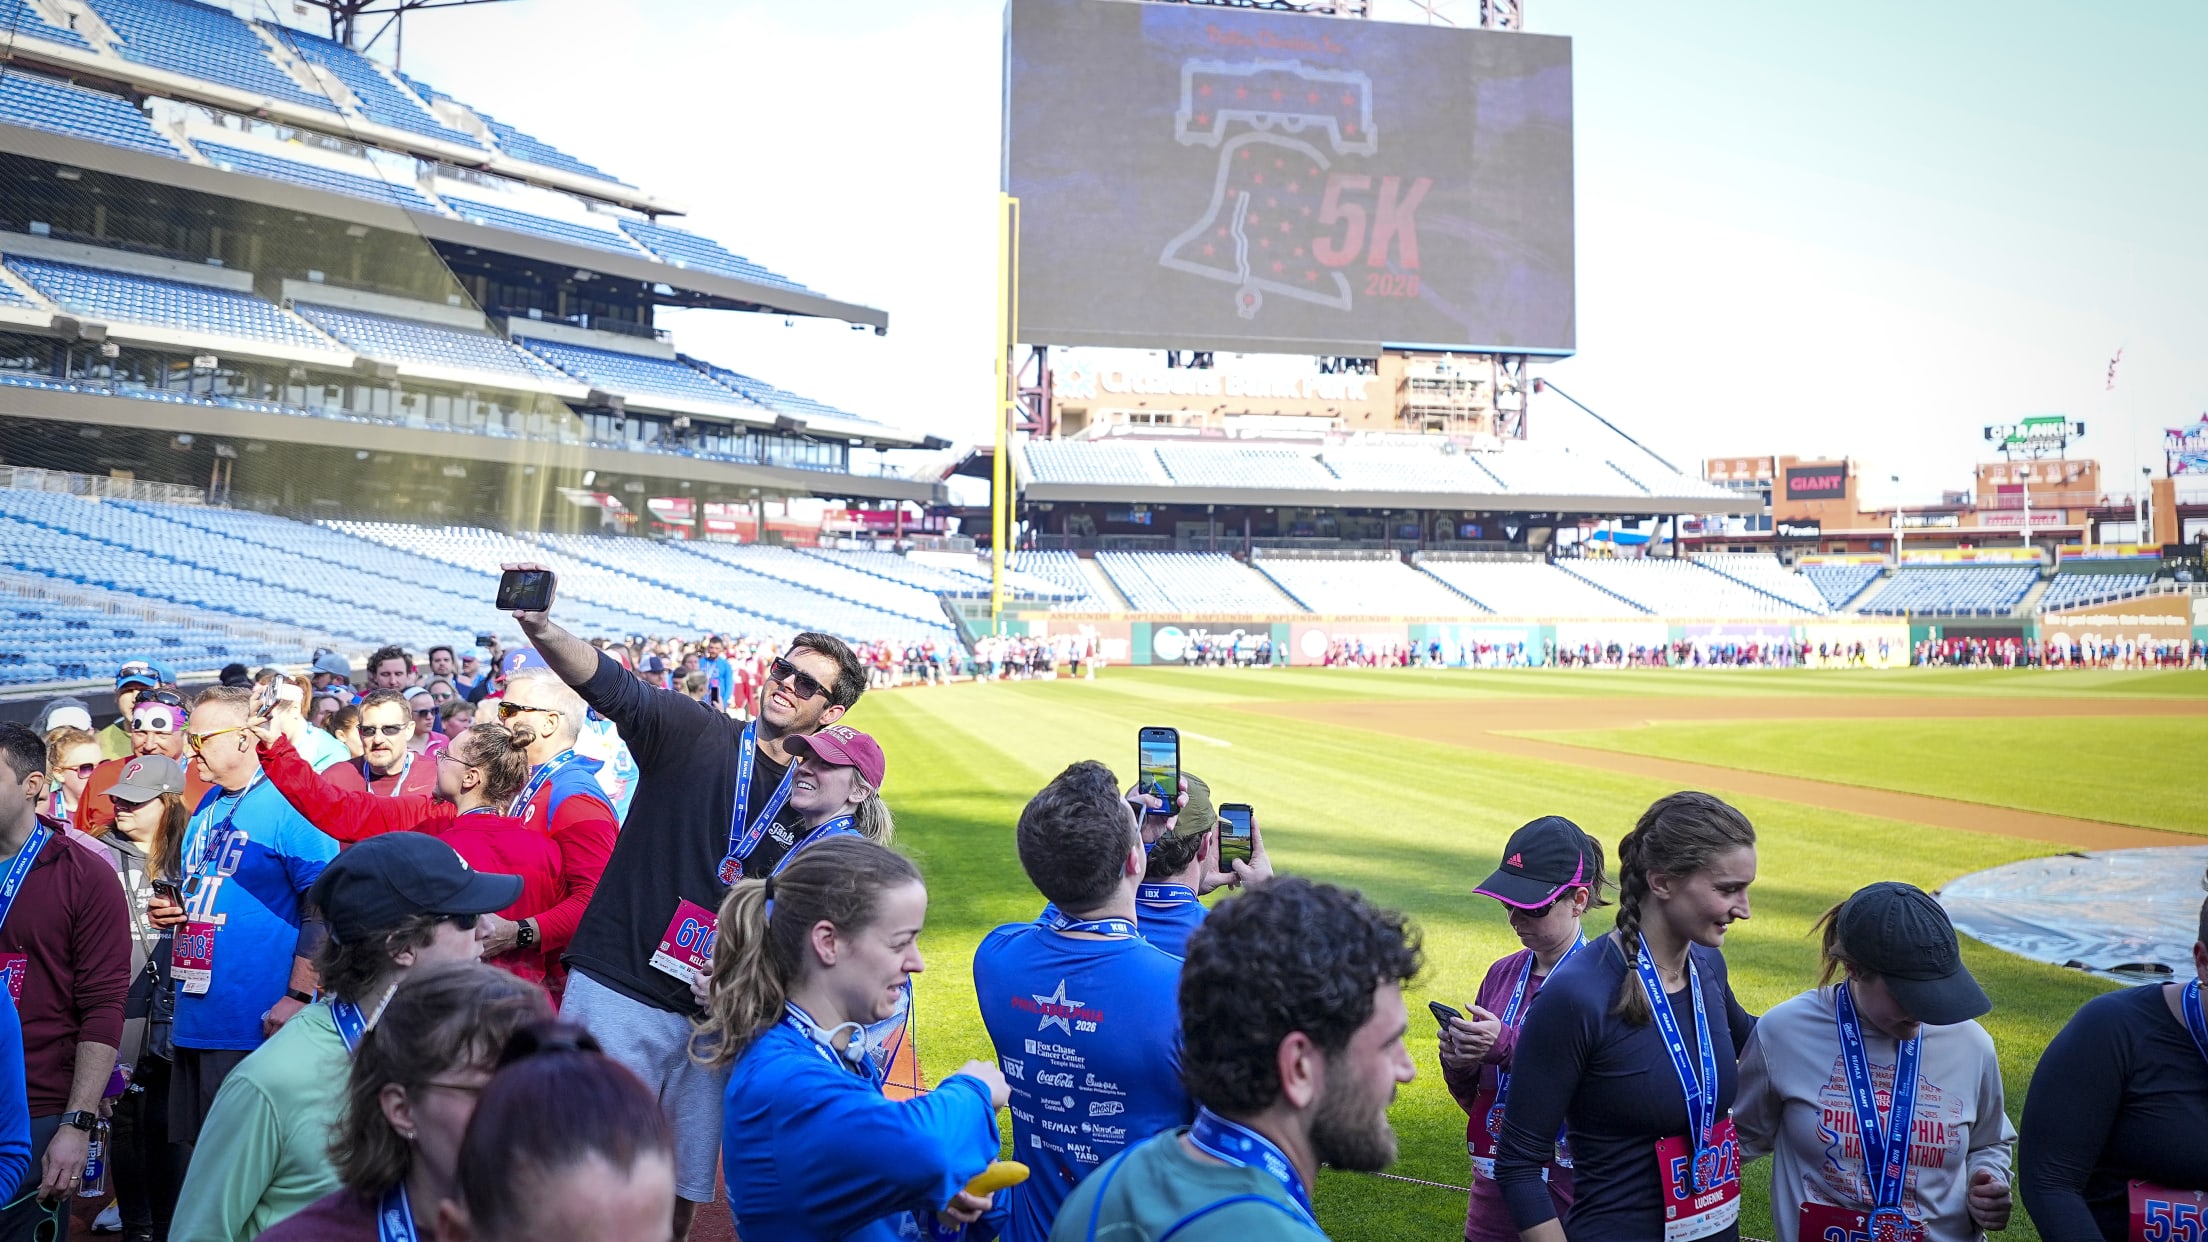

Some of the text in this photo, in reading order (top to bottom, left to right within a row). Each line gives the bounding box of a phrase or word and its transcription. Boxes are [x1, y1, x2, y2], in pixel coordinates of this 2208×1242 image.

[1312, 173, 1435, 269] 5K
[1365, 272, 1421, 297] 2026
[1790, 475, 1841, 491] GIANT
[768, 822, 795, 846] Tank
[1145, 890, 1159, 898] IBX
[1011, 996, 1104, 1023] PHILADELPHIA
[1648, 978, 1662, 1005] RE/MAX
[1662, 1012, 1674, 1032] GIANT
[1075, 1020, 1097, 1033] 2026
[1037, 1041, 1076, 1055] Fox Chase
[1037, 1049, 1085, 1063] Cancer Center
[1003, 1060, 1024, 1080] IBX
[1037, 1070, 1075, 1088] Coca-Cola
[1851, 1055, 1862, 1079] RE/MAX
[1859, 1088, 1869, 1108] GIANT
[1041, 1097, 1061, 1106] Johnson
[1044, 1104, 1066, 1113] Controls
[1012, 1106, 1035, 1123] GIANT
[1042, 1120, 1077, 1135] RE/MAX
[1092, 1124, 1126, 1134] NovaCare
[1042, 1140, 1064, 1153] TOYOTA
[1067, 1143, 1091, 1152] NAVY
[85, 1140, 97, 1177] smart
[1074, 1151, 1099, 1161] YARD
[1670, 1139, 1736, 1201] 522
[1695, 1189, 1724, 1210] LUCIENNE
[2144, 1199, 2208, 1242] 55
